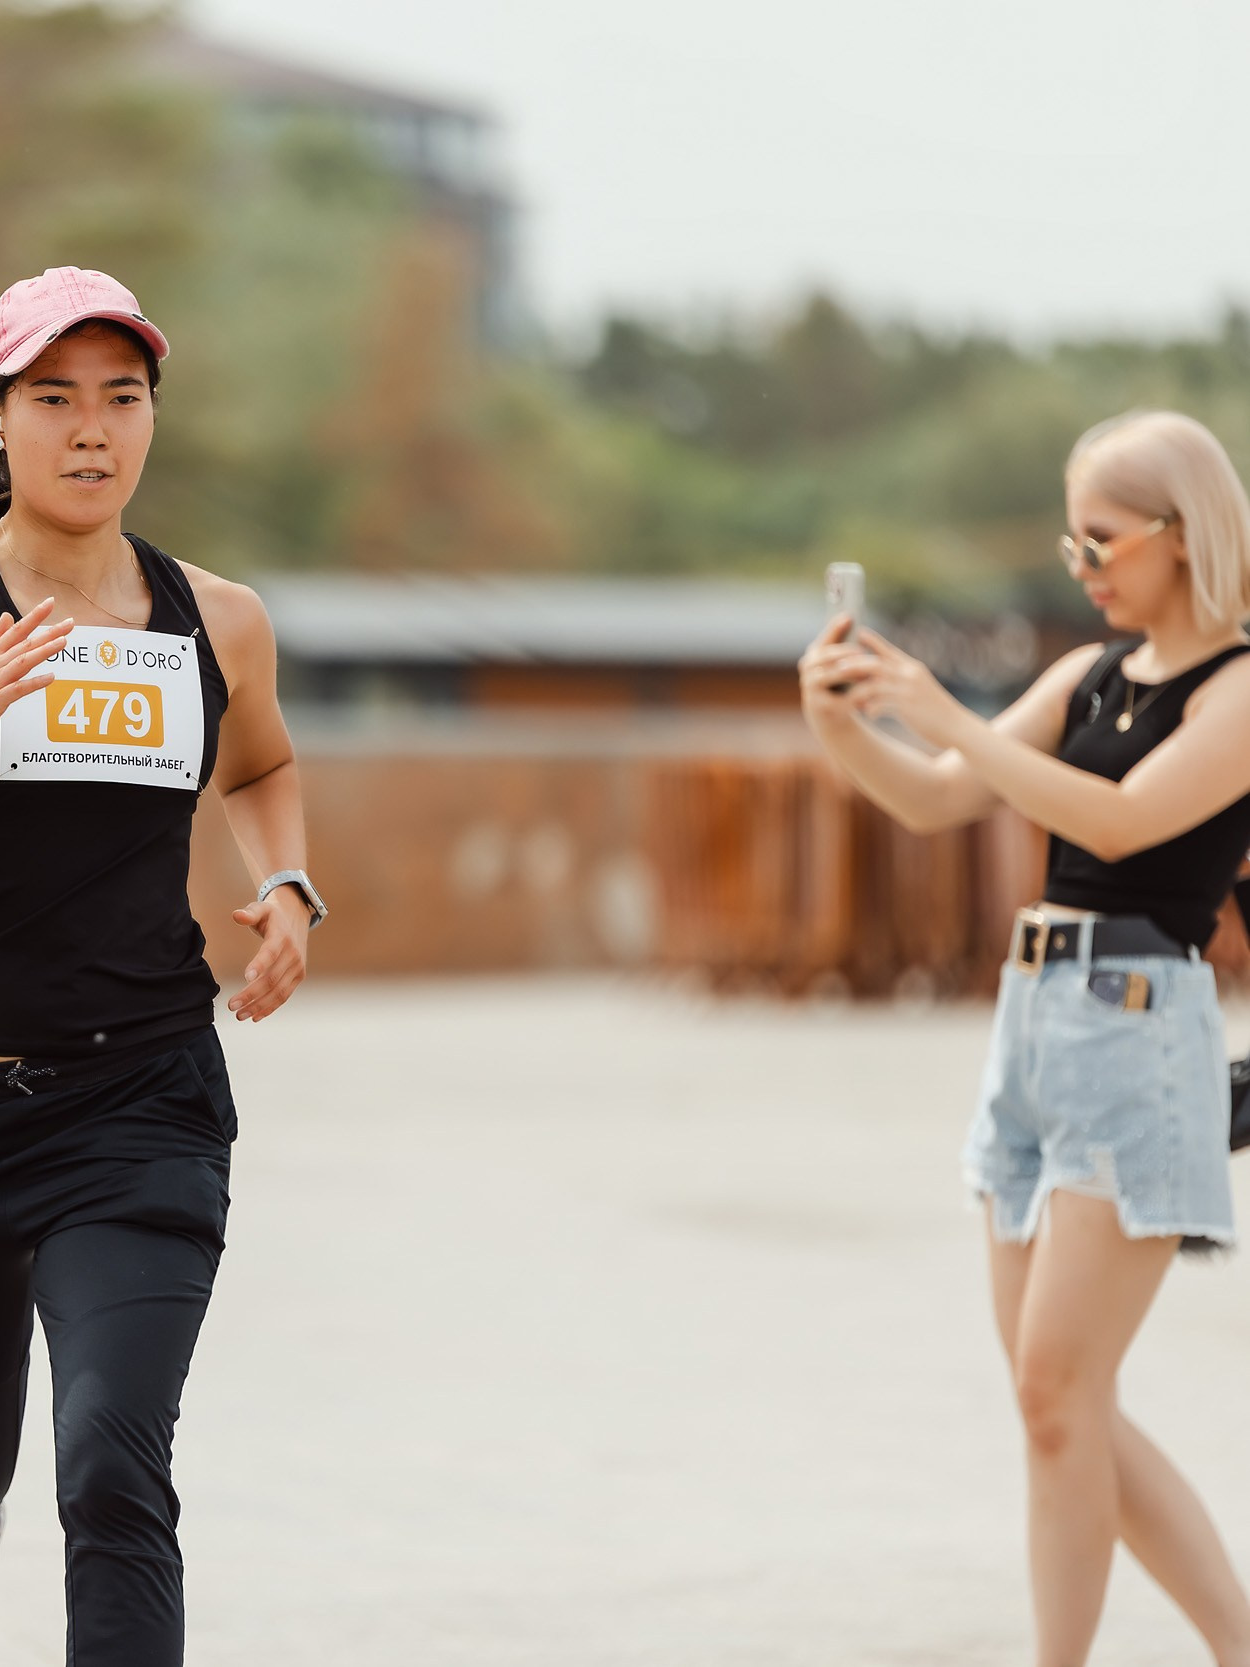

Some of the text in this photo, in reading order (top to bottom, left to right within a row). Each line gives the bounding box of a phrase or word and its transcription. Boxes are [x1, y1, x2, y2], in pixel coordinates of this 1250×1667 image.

[126, 649, 182, 670] D'ORO
[58, 688, 151, 738] 479
[22, 752, 184, 771] БЛАГОТВОРИТЕЛЬНЫЙ ЗАБЕГ
